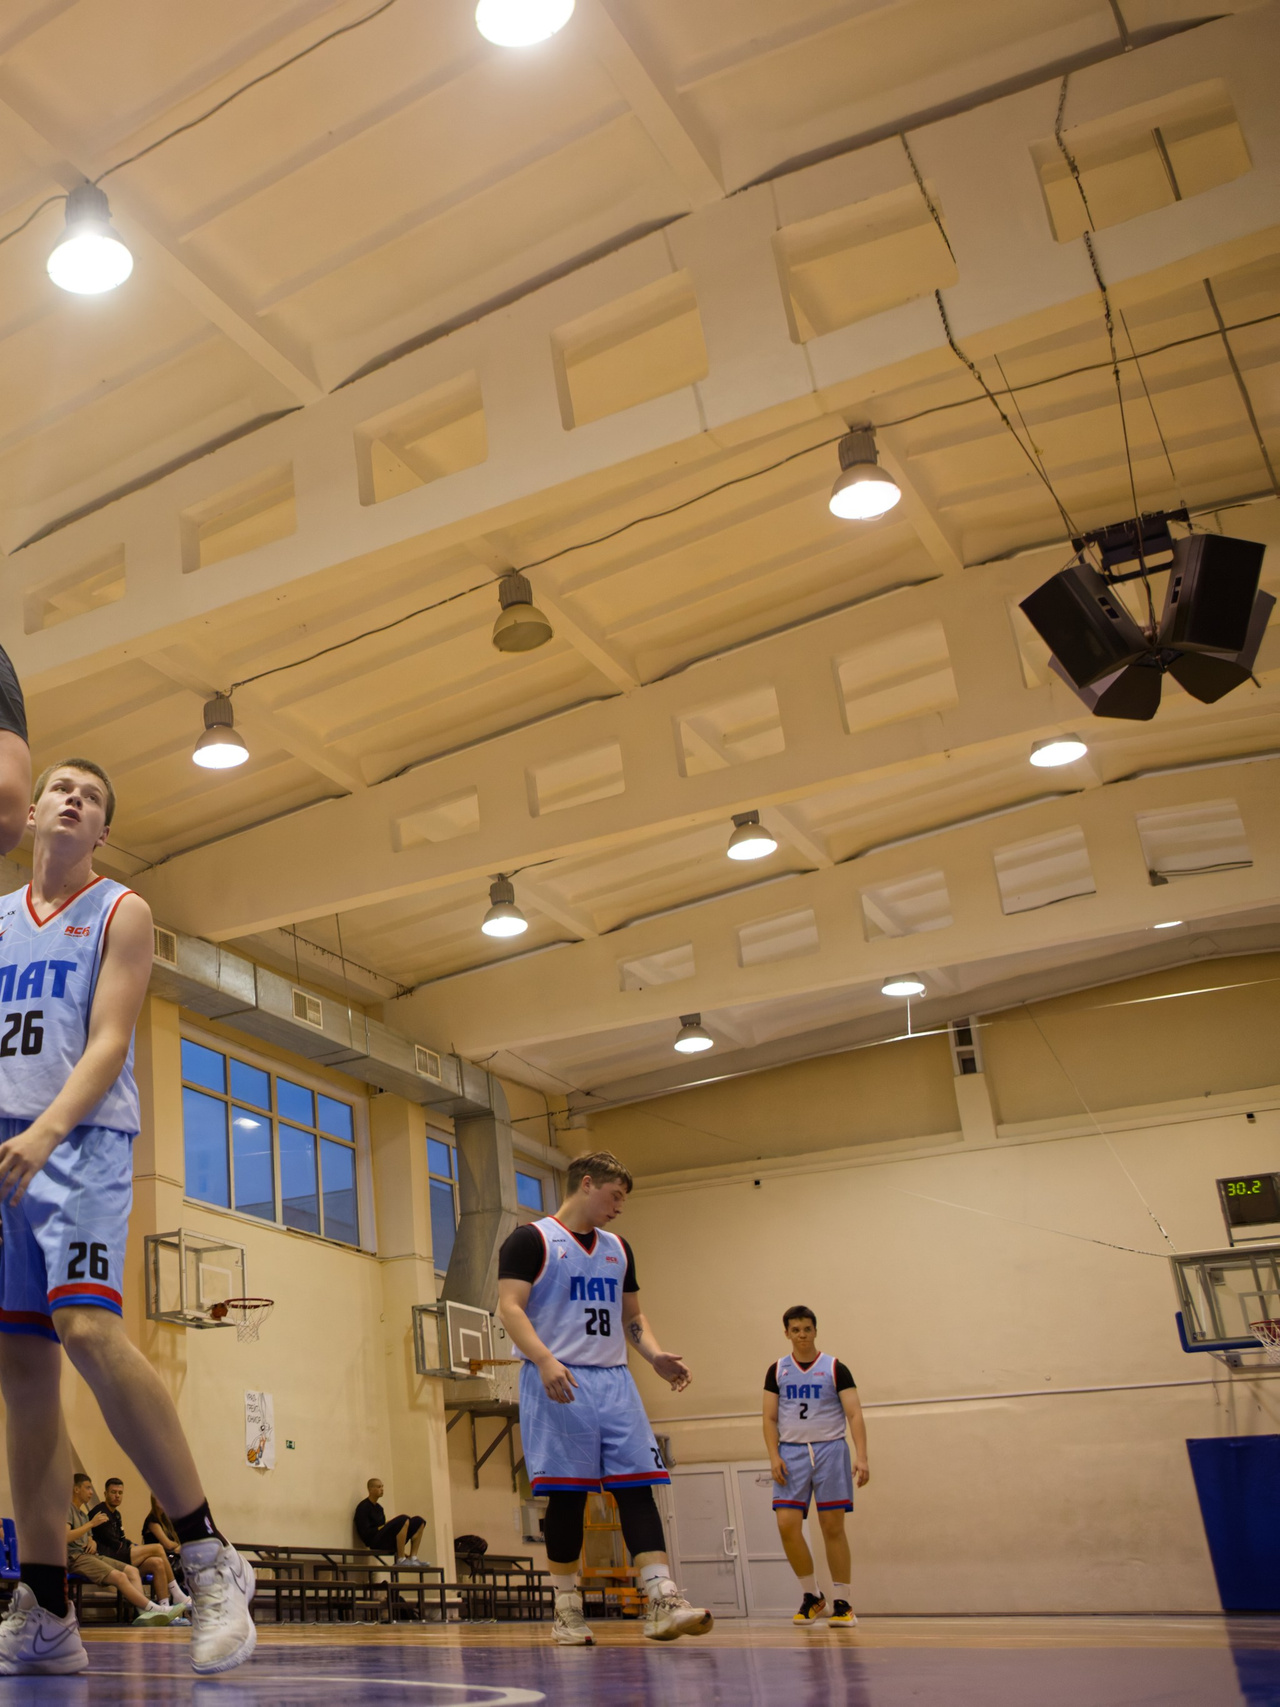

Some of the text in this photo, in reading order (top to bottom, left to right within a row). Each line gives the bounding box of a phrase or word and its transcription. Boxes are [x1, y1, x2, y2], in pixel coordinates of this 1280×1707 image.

[0, 1010, 44, 1057] 26
[1227, 1180, 1261, 1197] 30.2
[67, 1241, 109, 1281] 26
[570, 1276, 618, 1303] ПАТ
[584, 1308, 611, 1337] 28
[786, 1384, 823, 1400] ПАТ
[799, 1403, 809, 1420] 2
